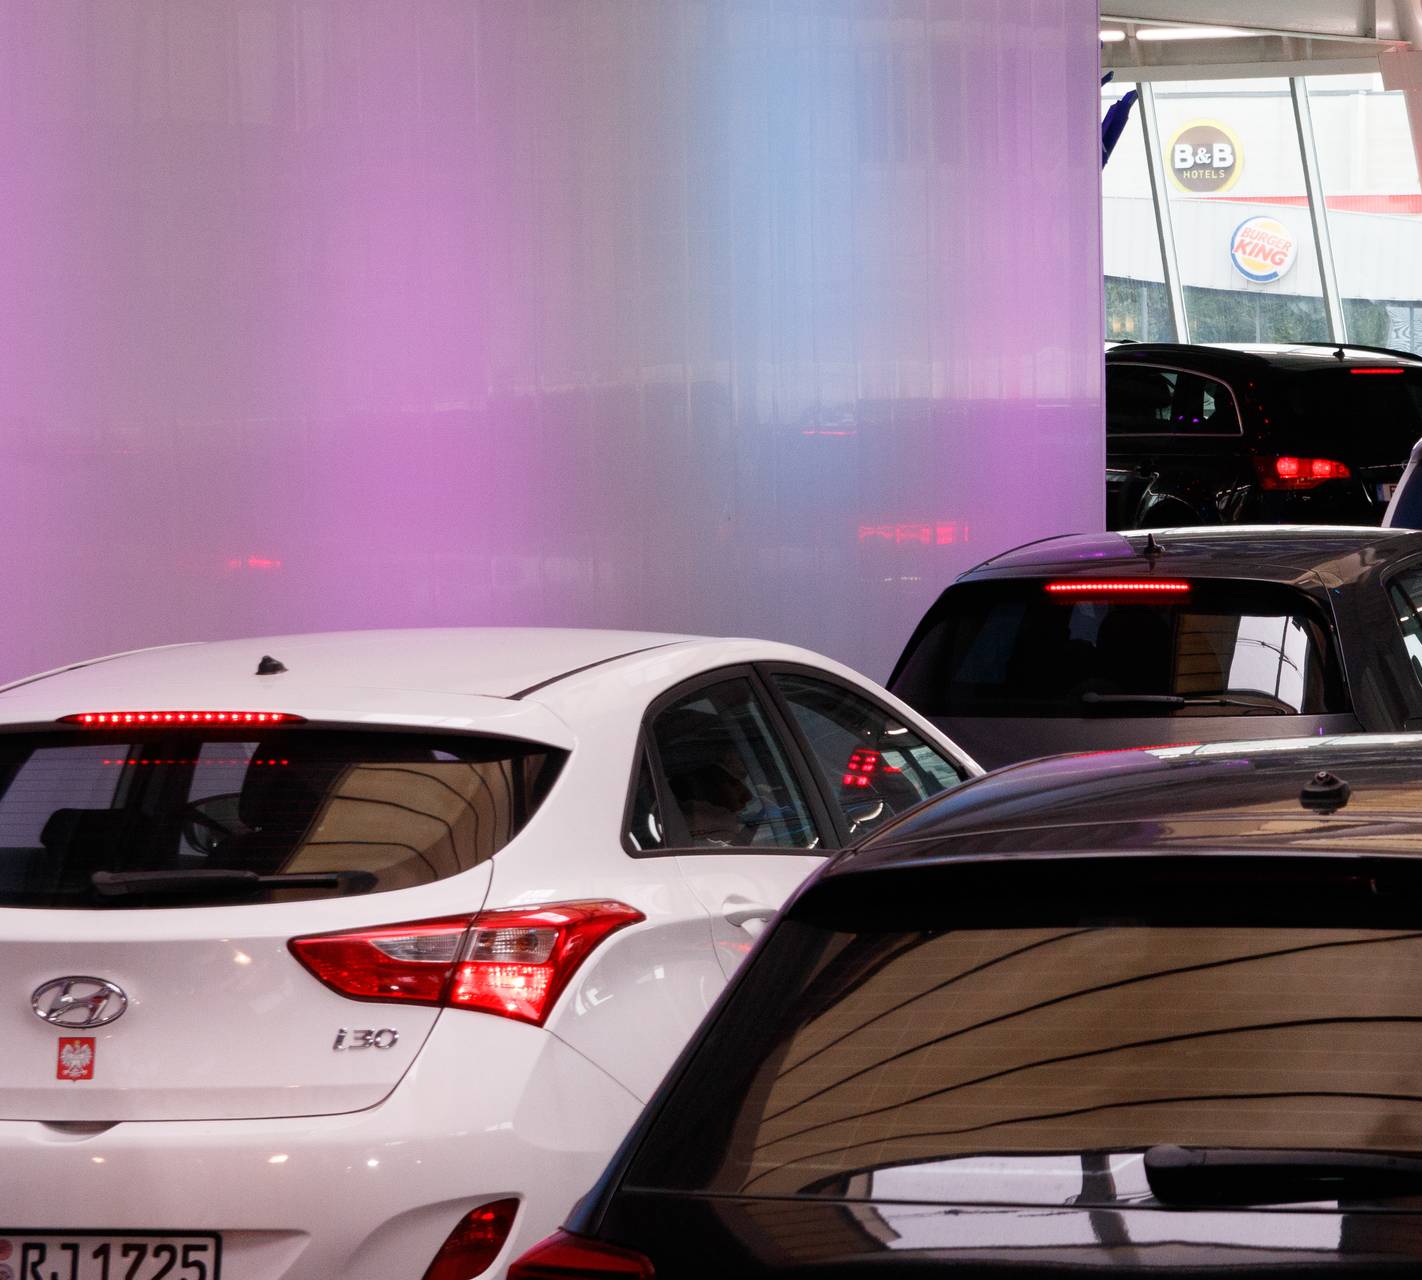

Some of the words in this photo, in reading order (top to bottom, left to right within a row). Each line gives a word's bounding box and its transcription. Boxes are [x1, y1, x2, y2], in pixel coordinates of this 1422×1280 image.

[1174, 143, 1234, 169] B&B
[1183, 169, 1225, 179] HOTELS
[1233, 238, 1288, 266] KING
[1240, 226, 1292, 252] BURGER
[332, 1027, 400, 1051] i30
